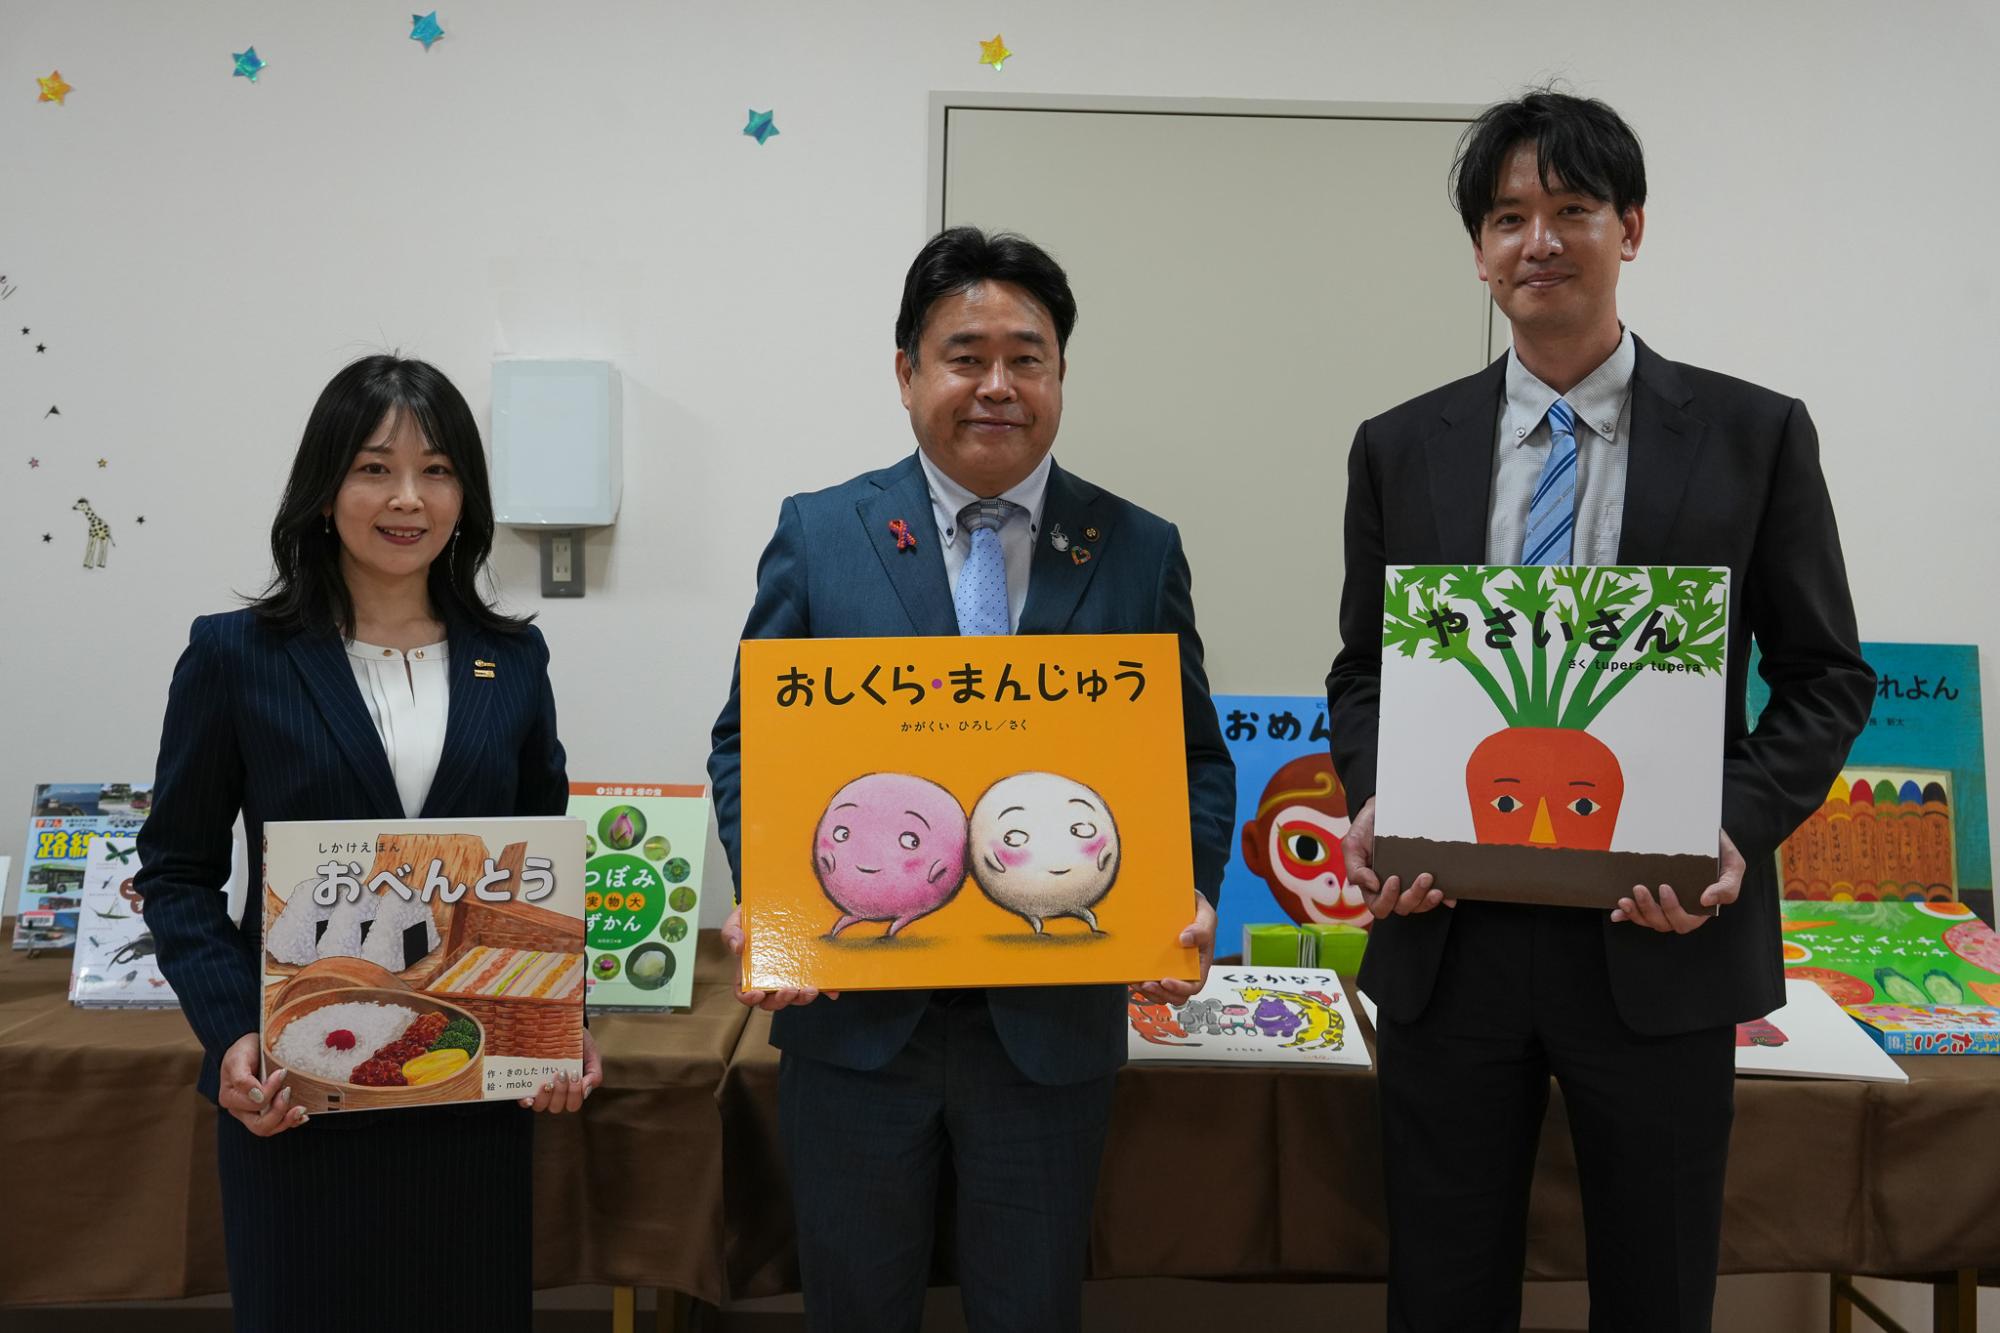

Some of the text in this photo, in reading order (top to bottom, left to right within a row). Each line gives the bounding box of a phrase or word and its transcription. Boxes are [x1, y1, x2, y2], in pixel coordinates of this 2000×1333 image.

[1426, 607, 1682, 653] やさいさん
[1594, 660, 1644, 673] tupera
[1651, 661, 1701, 674] tupera
[776, 660, 1147, 706] おしくら・まんじゅう
[901, 721, 950, 732] かがくい
[318, 842, 401, 854] しかけえほん
[312, 857, 556, 906] おべんとう
[586, 893, 643, 910] 実物大
[586, 913, 642, 932] ずかん
